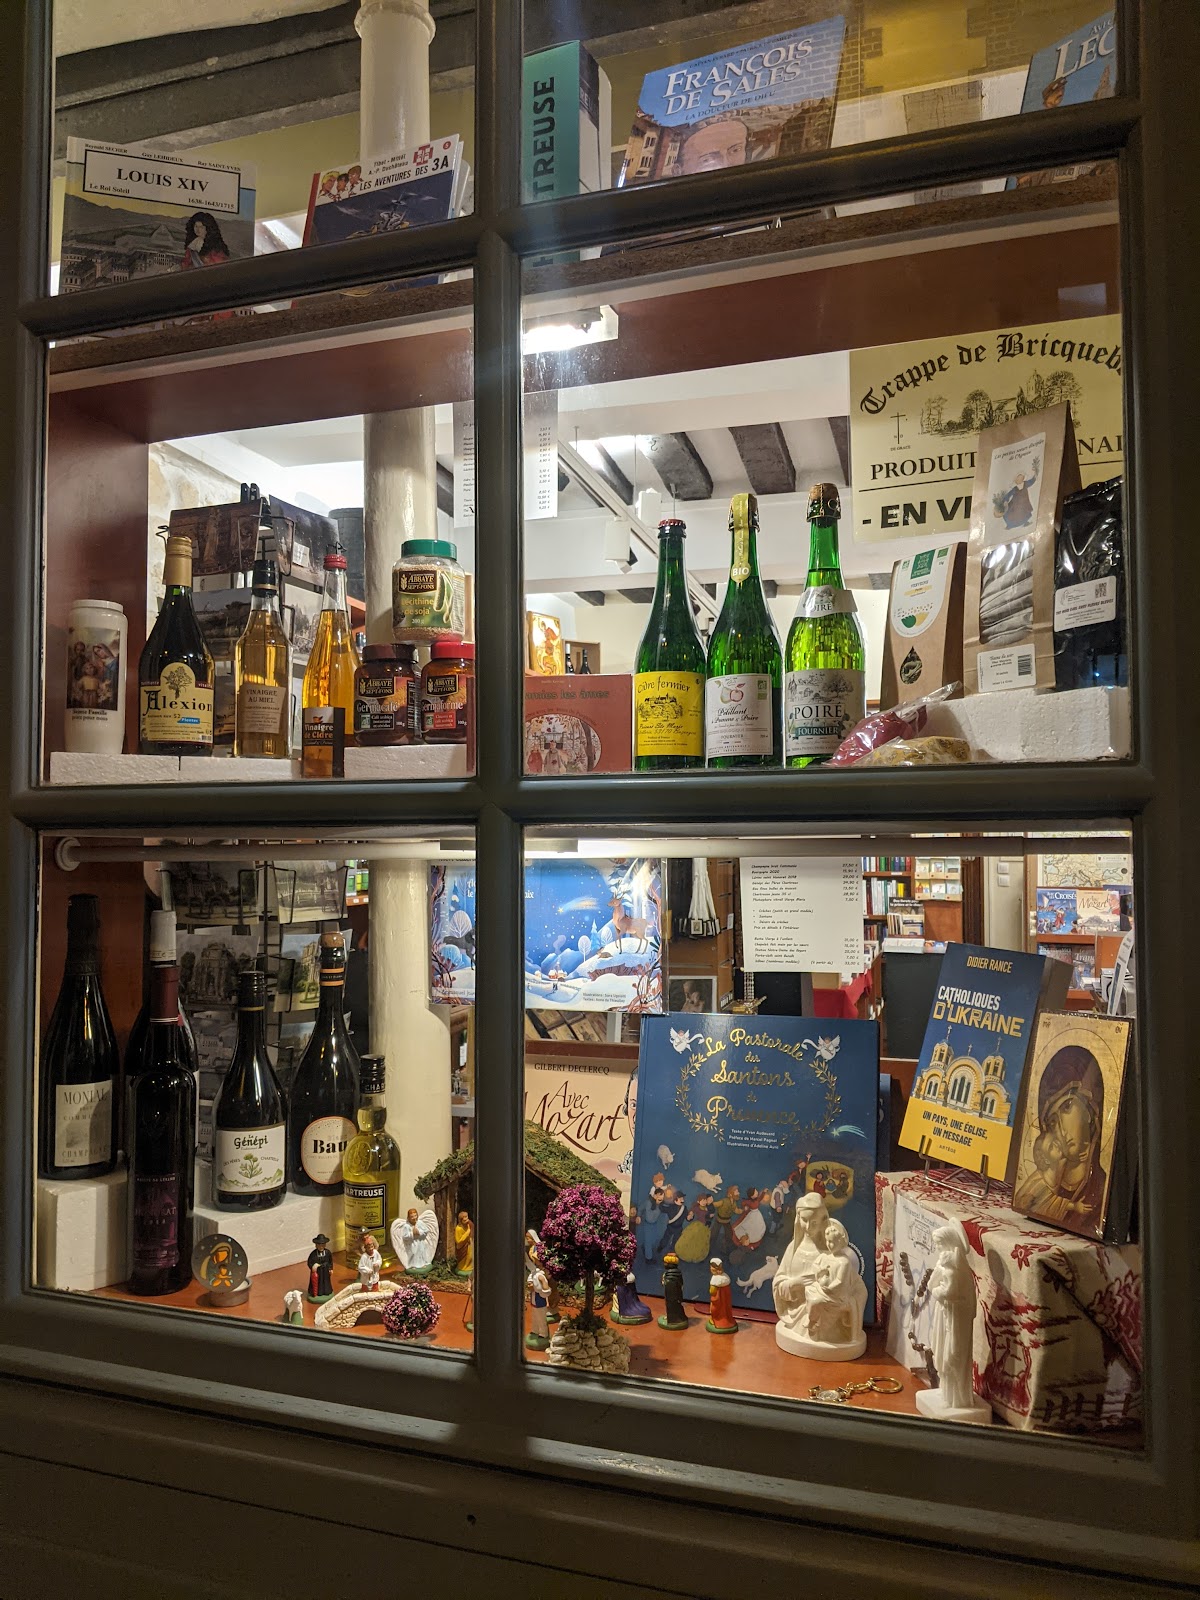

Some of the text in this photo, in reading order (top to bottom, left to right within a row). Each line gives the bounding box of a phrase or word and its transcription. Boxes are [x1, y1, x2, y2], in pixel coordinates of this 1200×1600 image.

[662, 39, 812, 98] FRANÇOIS
[666, 60, 801, 115] DE SALES
[685, 90, 775, 121] LA DOUCEUR DE DIEU
[116, 168, 209, 192] LOUIS XIV
[360, 180, 372, 191] LES
[374, 170, 411, 187] AVENTURES
[415, 164, 429, 177] DES
[112, 186, 130, 194] Soleil
[860, 354, 950, 415] Trappe
[956, 344, 987, 366] de
[881, 501, 927, 529] EN
[408, 575, 434, 583] ABBAYE
[732, 567, 750, 576] BIO
[415, 606, 430, 616] soja
[366, 679, 392, 687] ABBAYE
[658, 676, 691, 692] fermier
[246, 689, 278, 697] VINAIGRE
[142, 690, 212, 716] Alexion
[794, 702, 843, 720] POIRÉ
[304, 724, 334, 732] Vinaigre
[312, 731, 333, 739] Cidre
[798, 726, 839, 736] FOURNIER
[1079, 894, 1109, 910] Mozart
[966, 956, 1014, 974] DIDIER RANCE
[938, 986, 1002, 1011] CATHOLIQUES
[932, 1001, 1025, 1038] D'UKRAINE
[705, 1028, 804, 1061] La Pastorale
[745, 1051, 760, 1064] des
[534, 1063, 610, 1075] GILBERT DECLERCQ
[710, 1059, 795, 1087] Santons
[64, 1088, 108, 1105] MONIAL
[365, 1083, 386, 1092] CHAR
[548, 1080, 590, 1110] Avec
[707, 1095, 800, 1126] Provence
[922, 1110, 988, 1140] UN PAYS, UNE ÉGLISE,
[234, 1135, 269, 1150] Génépi
[932, 1127, 972, 1147] UN MESSAGE
